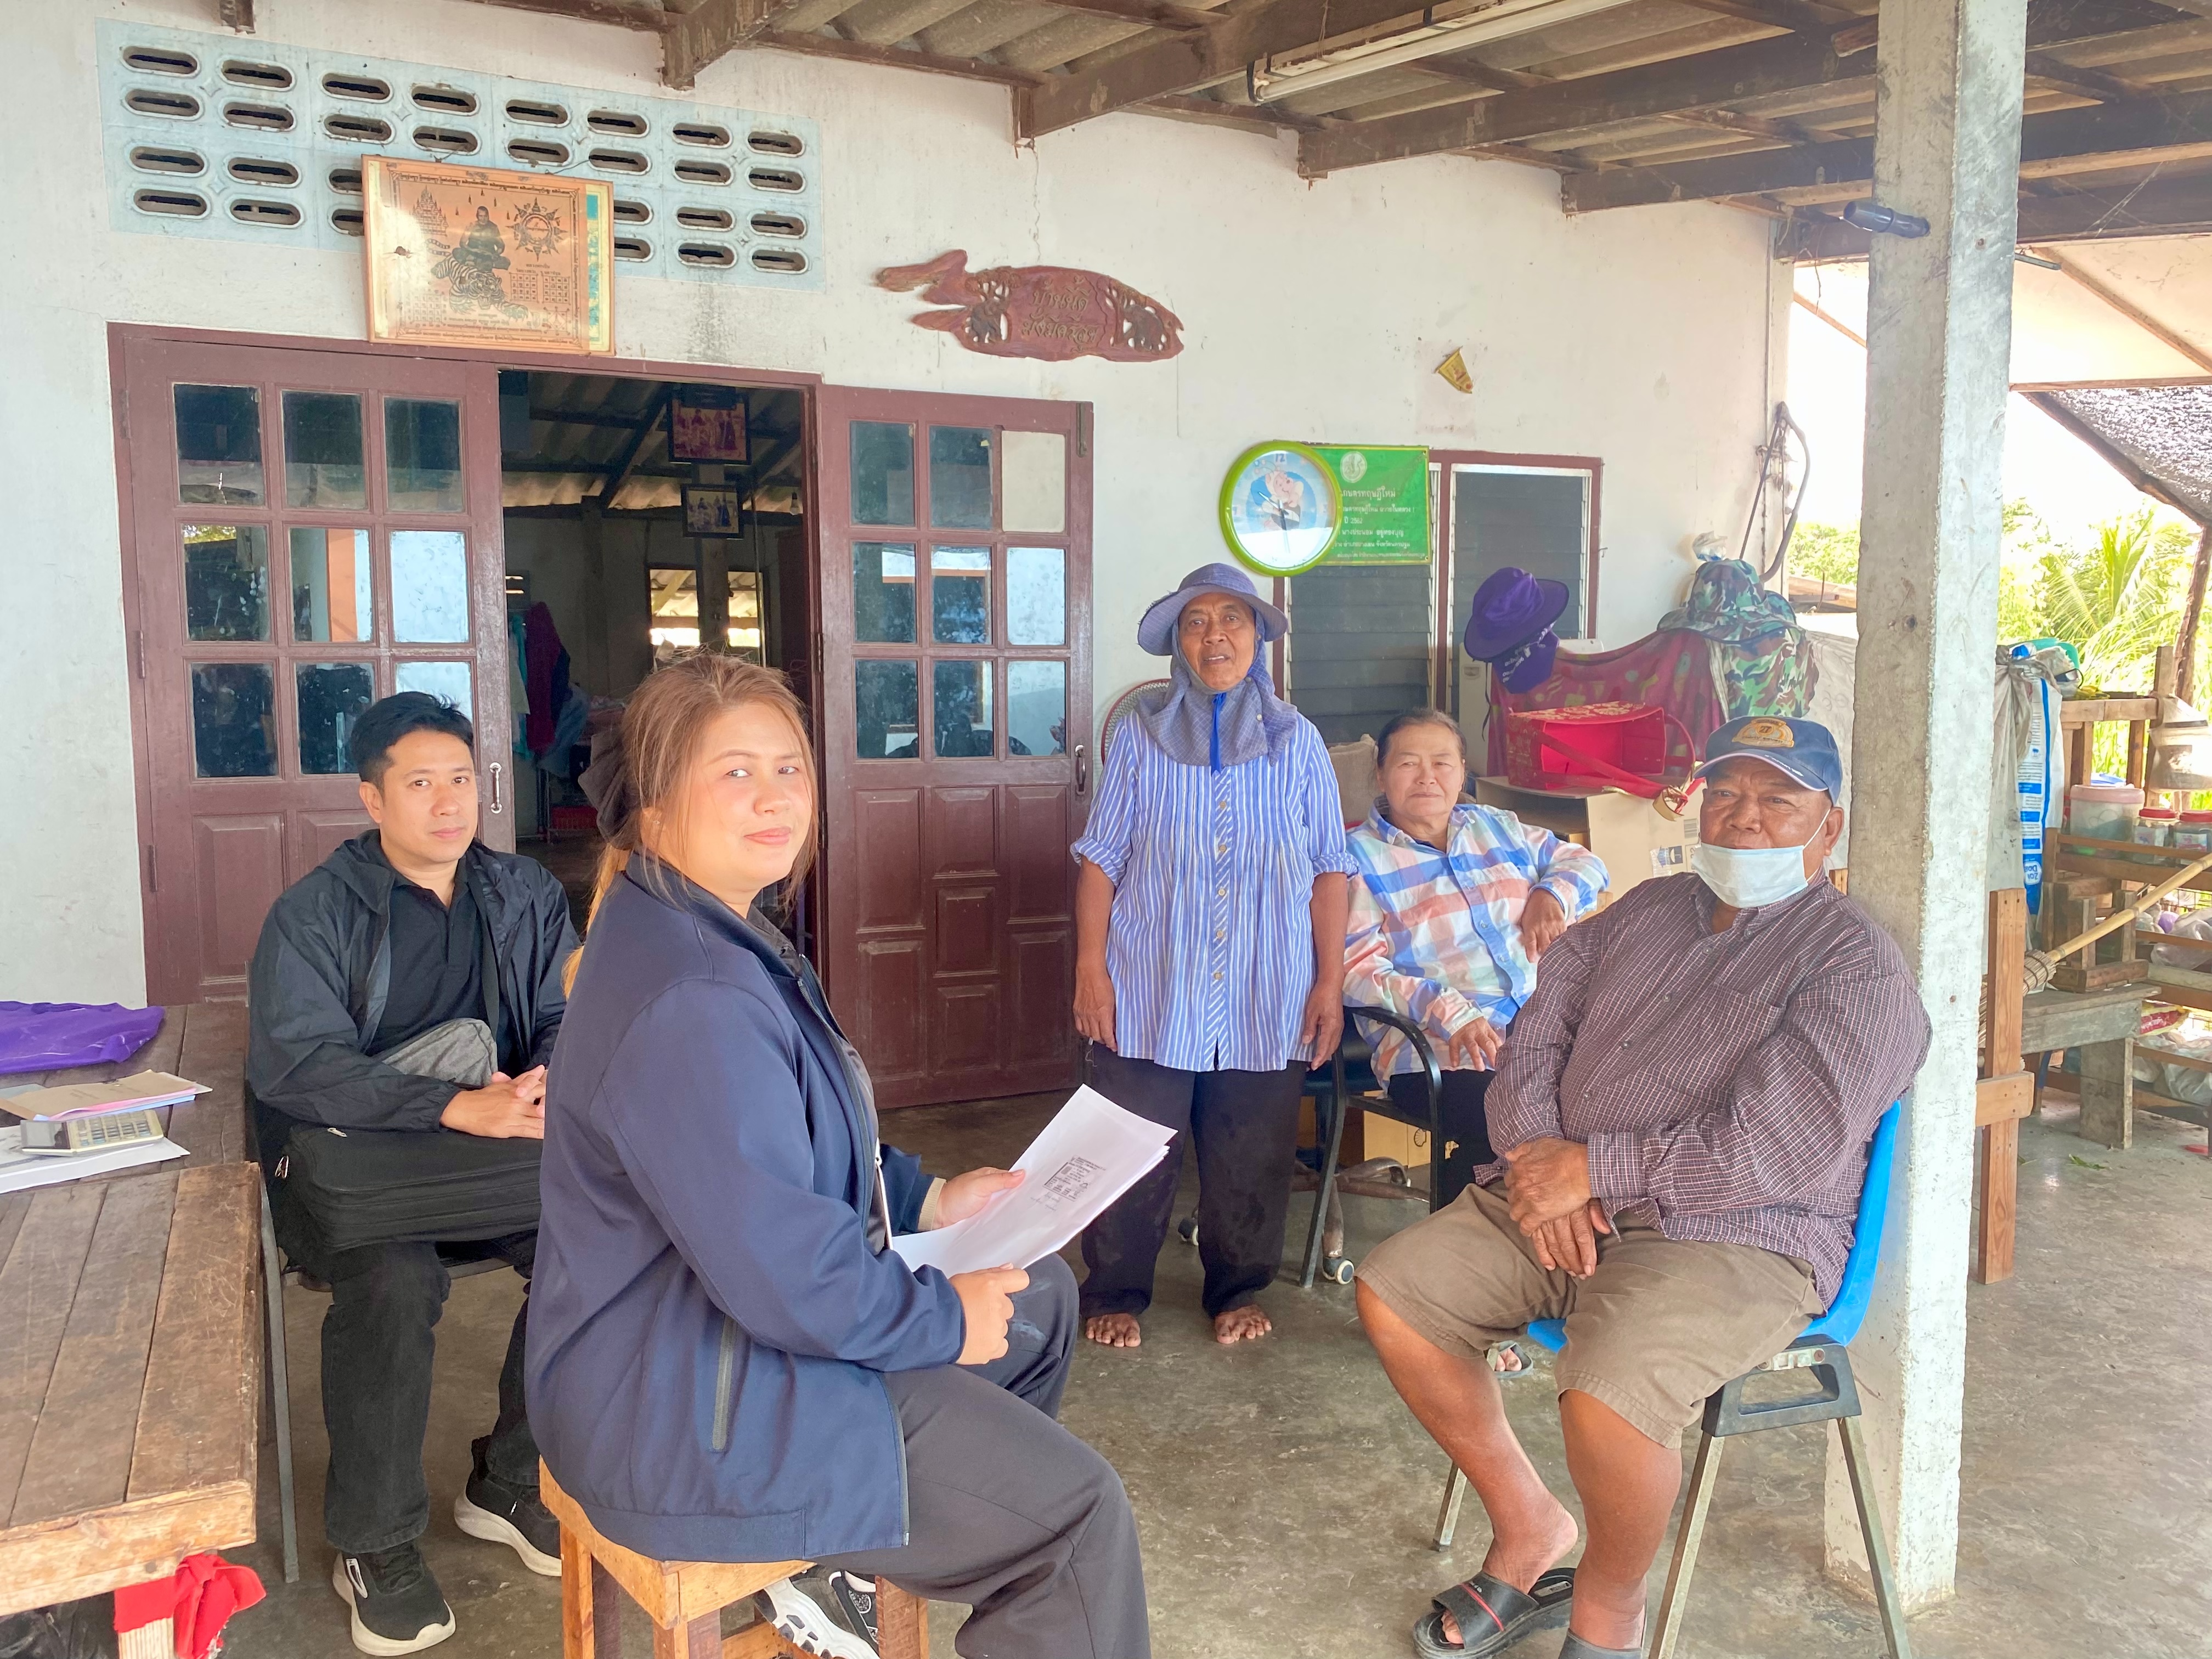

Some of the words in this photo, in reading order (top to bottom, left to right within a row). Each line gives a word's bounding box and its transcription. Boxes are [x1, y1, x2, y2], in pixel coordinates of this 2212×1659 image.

[1033, 275, 1091, 312] บ้านนี้ดี
[1022, 307, 1100, 353] มั่งมีศรีสุข
[1276, 454, 1285, 462] 12
[1344, 515, 1348, 524] ปี
